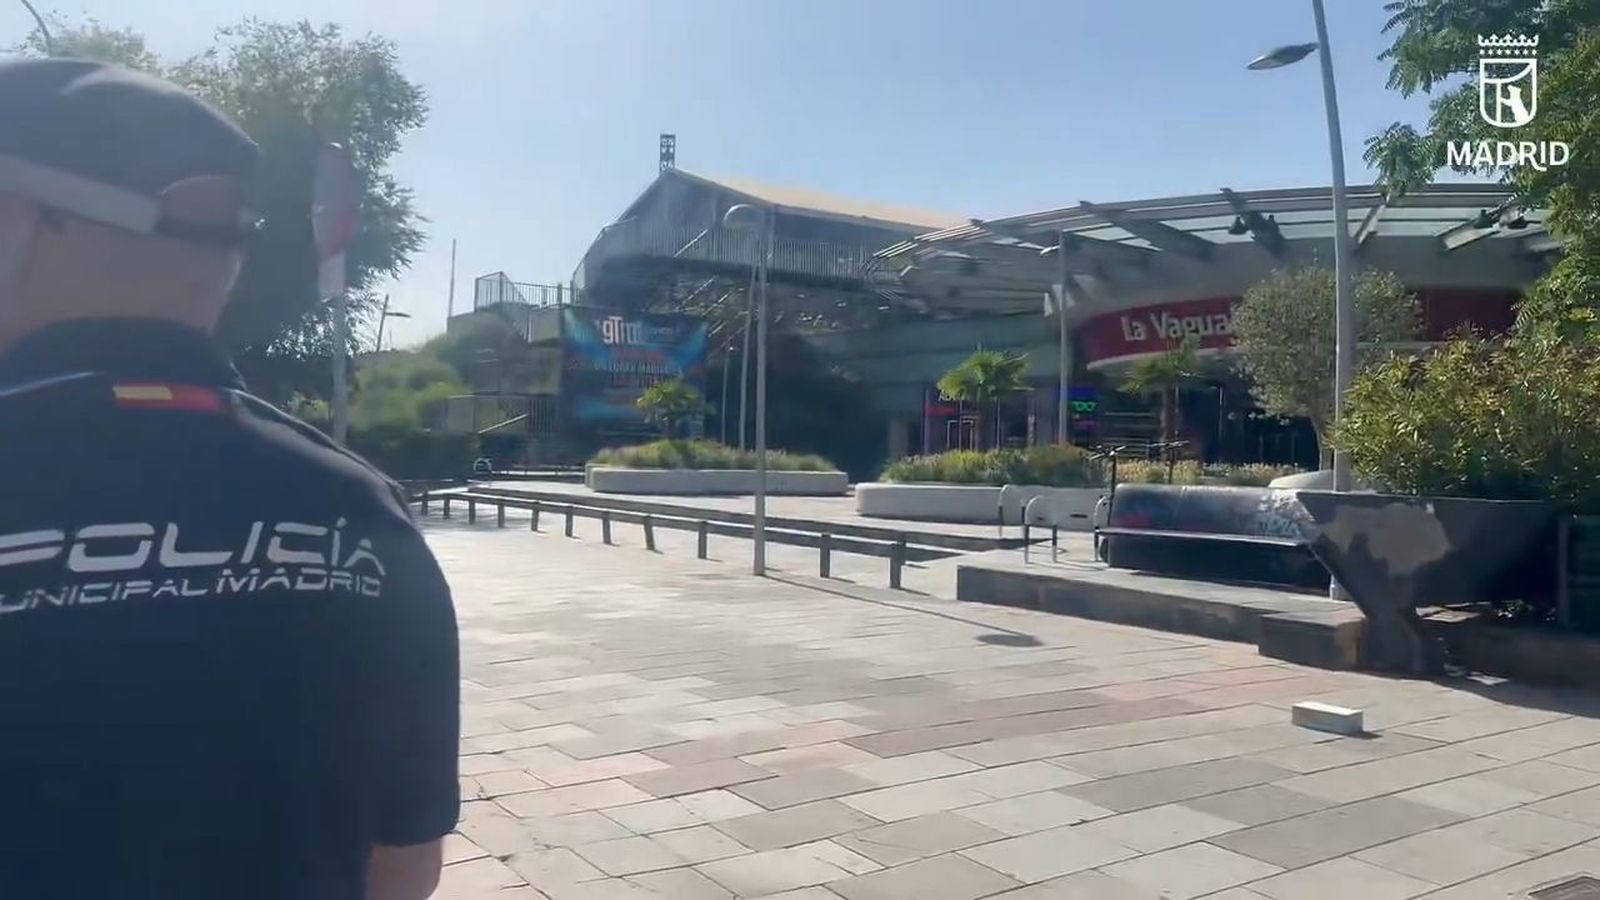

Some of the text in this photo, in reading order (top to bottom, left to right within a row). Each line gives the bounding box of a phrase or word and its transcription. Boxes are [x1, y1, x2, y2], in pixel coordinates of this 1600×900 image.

[1120, 311, 1234, 341] La Vagua
[0, 567, 381, 613] UNICIPAL MADRID
